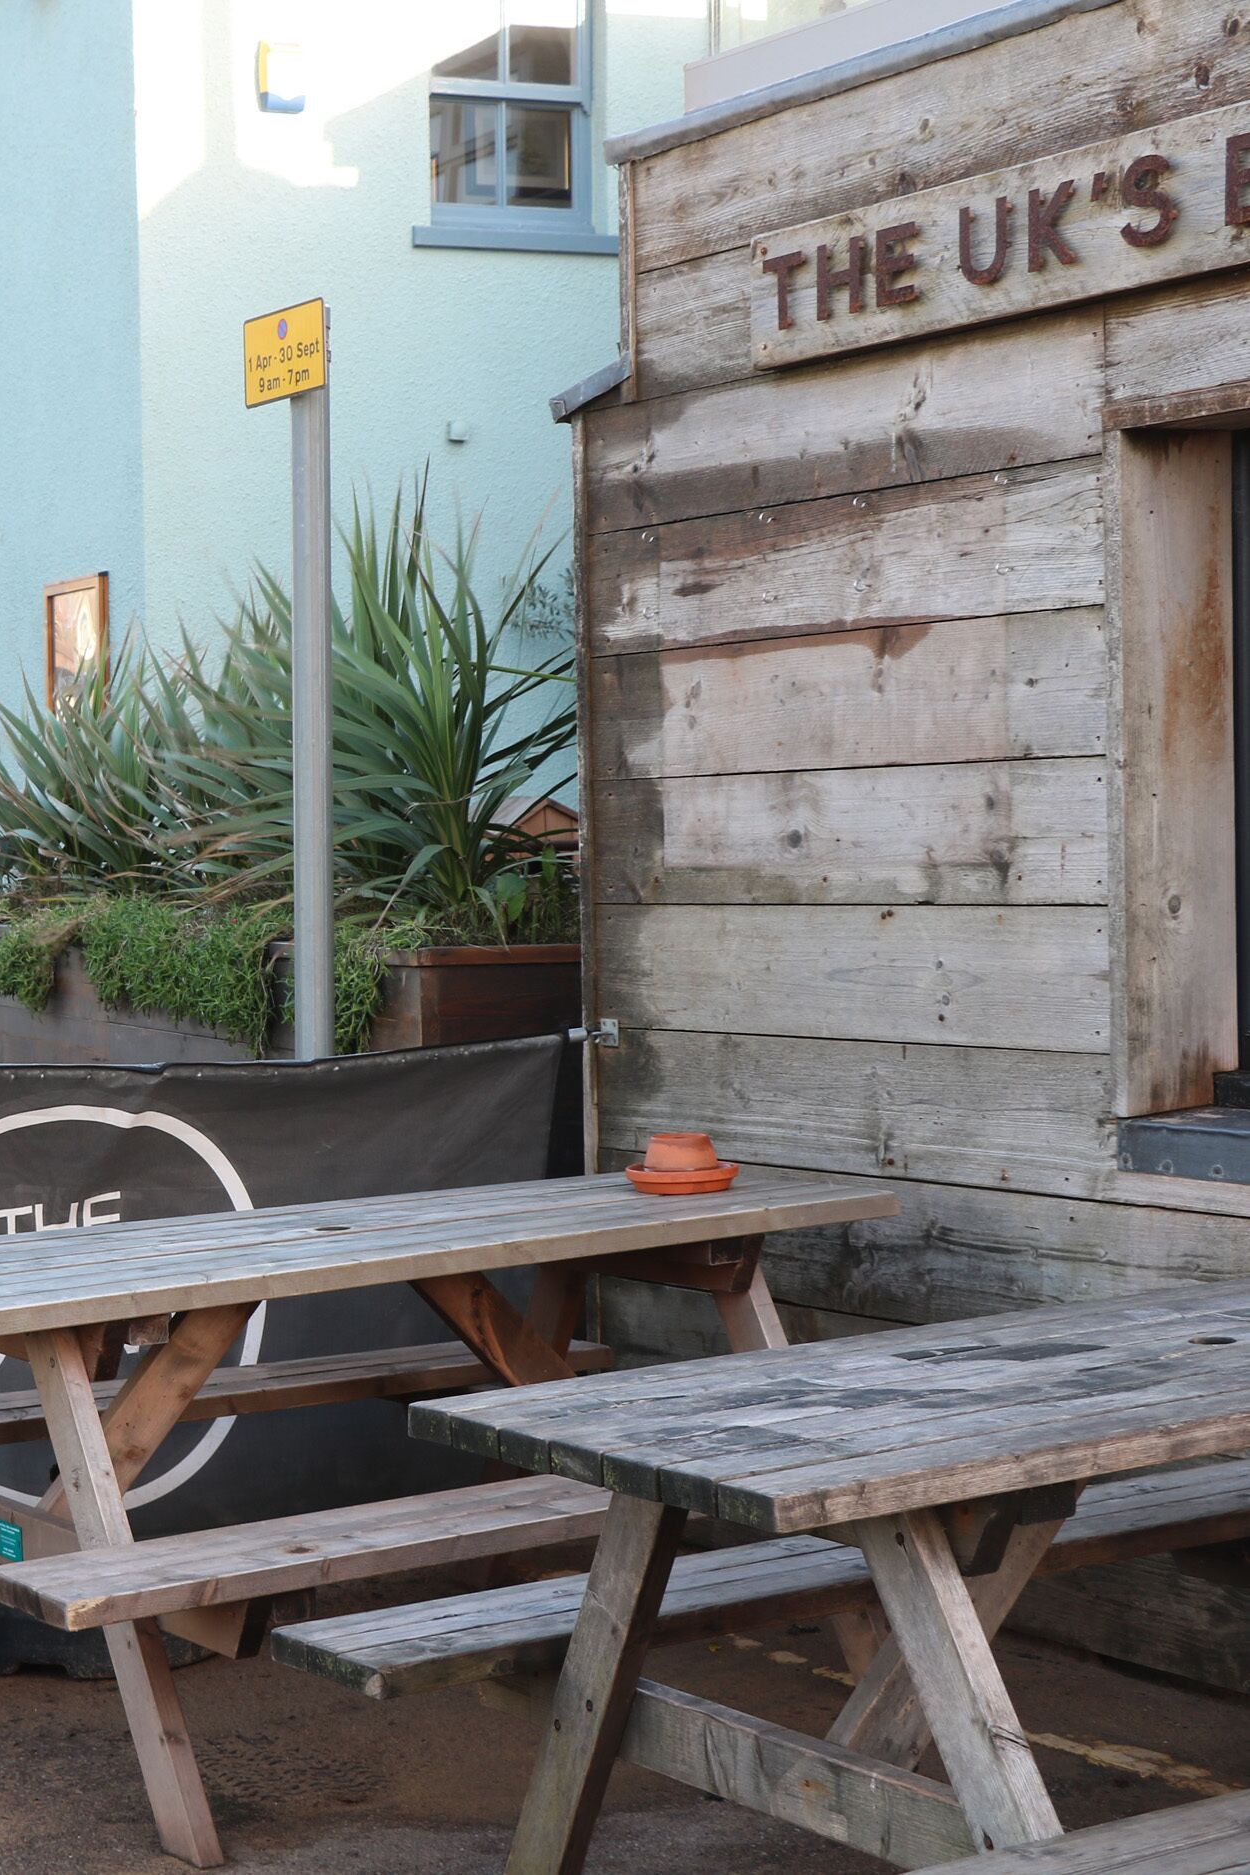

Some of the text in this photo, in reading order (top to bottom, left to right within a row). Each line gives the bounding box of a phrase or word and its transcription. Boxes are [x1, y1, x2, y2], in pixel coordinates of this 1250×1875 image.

[762, 221, 920, 331] THE
[958, 153, 1177, 286] UK'S
[248, 356, 253, 373] 1
[255, 353, 272, 373] Apr
[279, 344, 293, 364] 30
[296, 337, 320, 359] Sept
